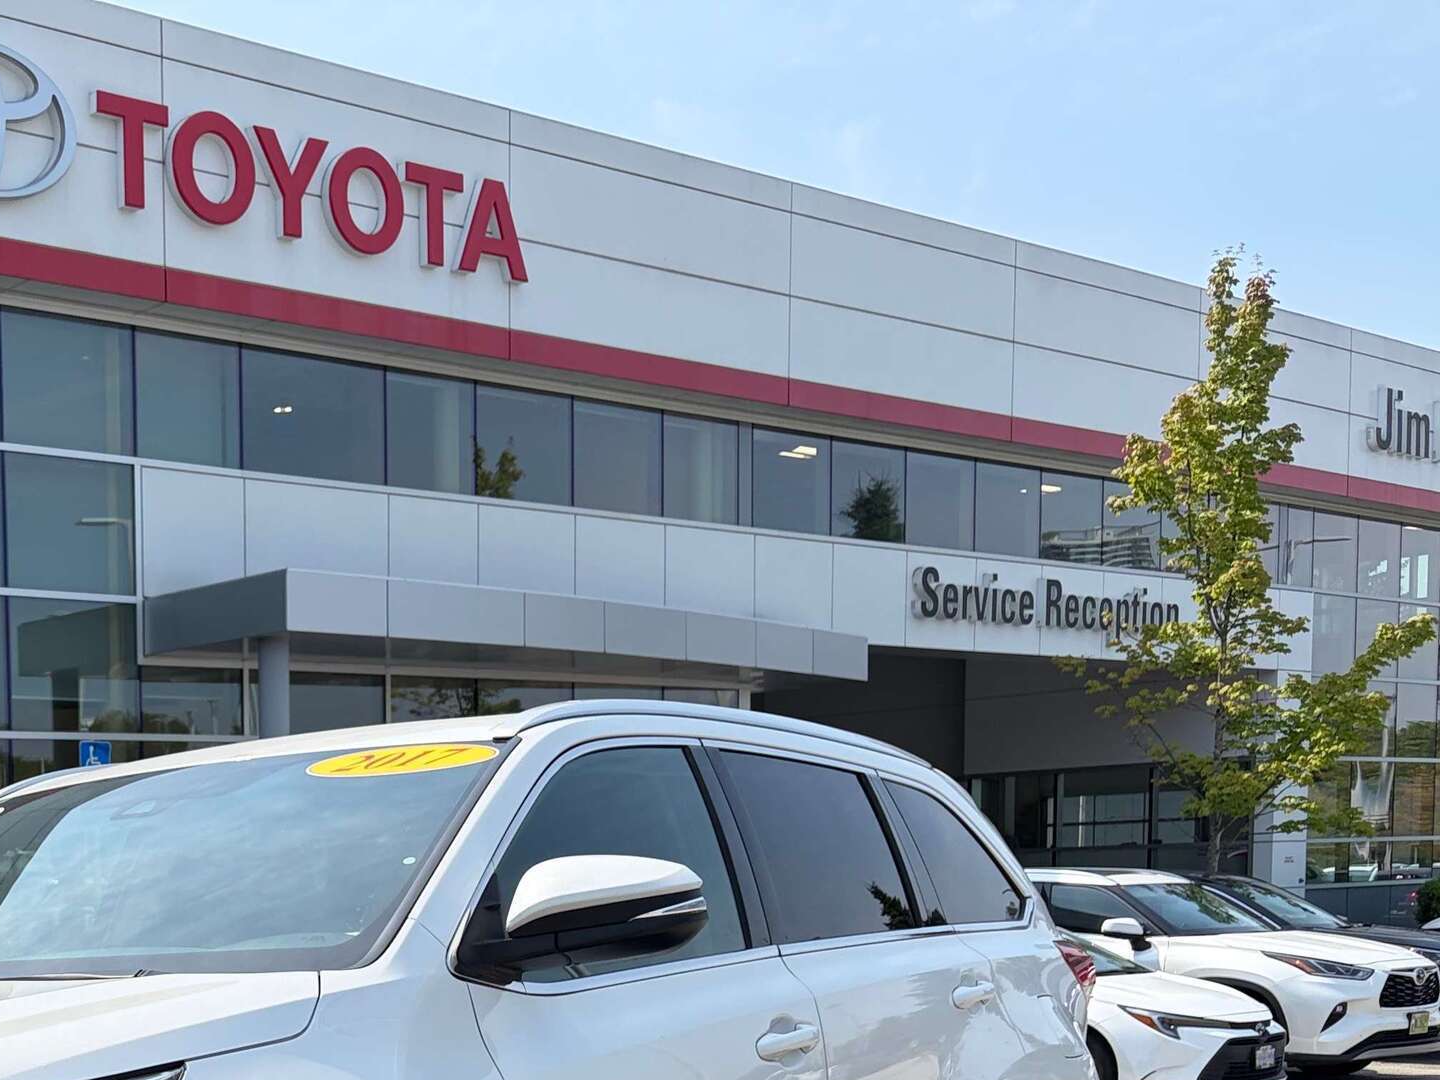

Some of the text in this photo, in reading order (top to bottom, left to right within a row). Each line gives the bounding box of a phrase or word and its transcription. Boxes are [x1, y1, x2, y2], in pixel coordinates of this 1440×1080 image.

[94, 89, 528, 283] TOYOTA
[1375, 386, 1431, 459] Jim
[918, 565, 1180, 641] Service Reception
[330, 747, 468, 773] 2017
